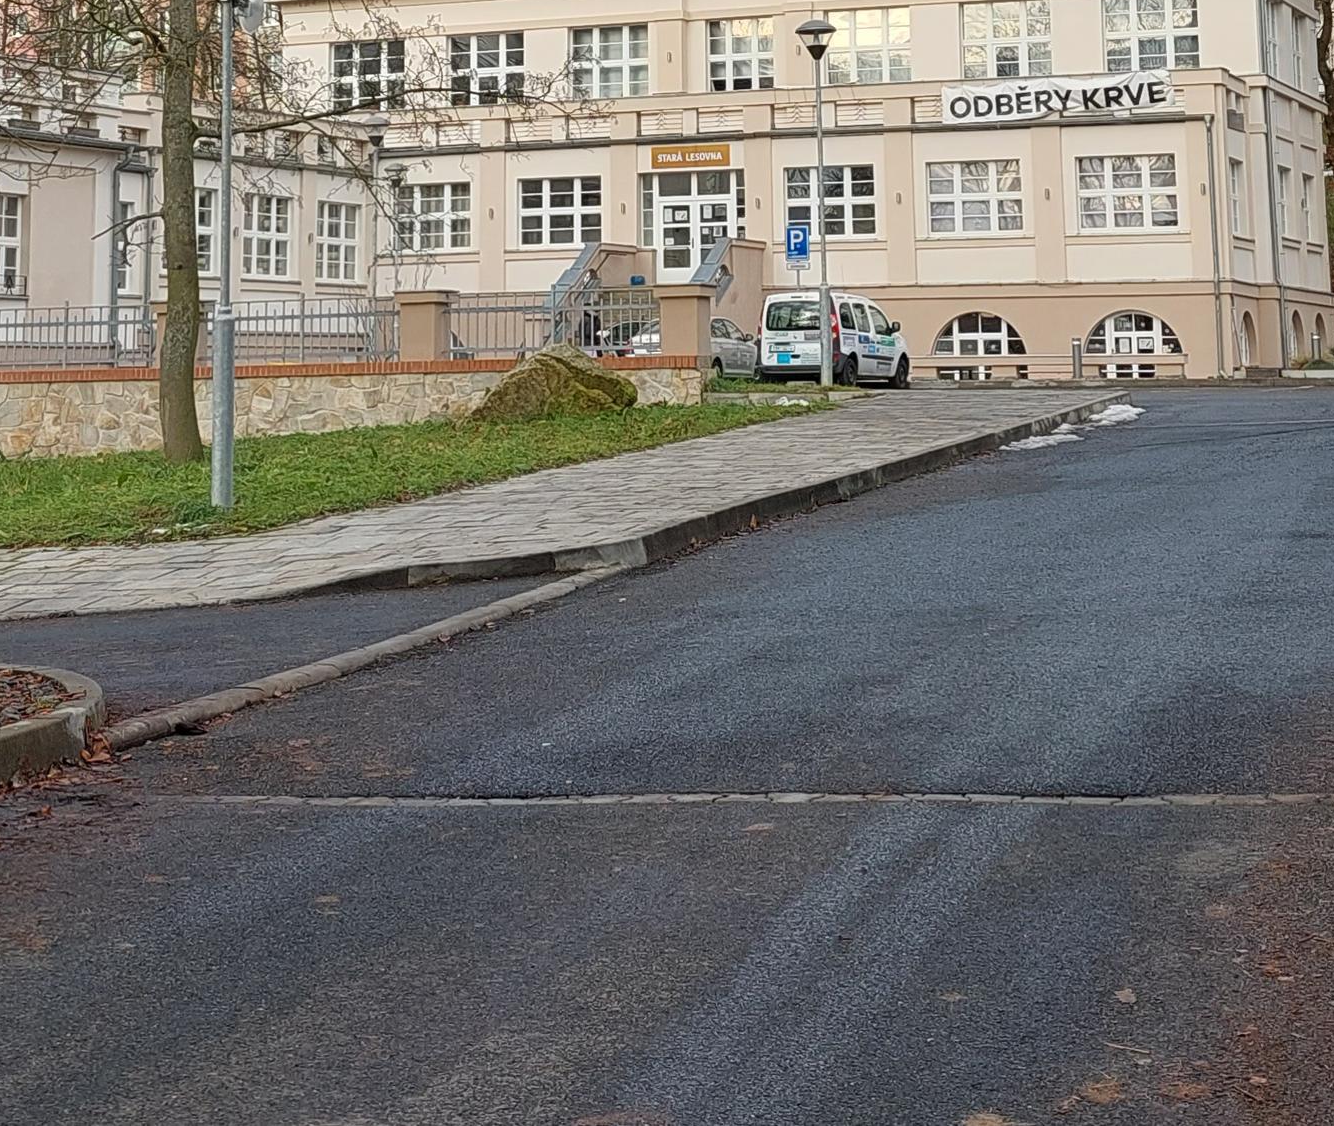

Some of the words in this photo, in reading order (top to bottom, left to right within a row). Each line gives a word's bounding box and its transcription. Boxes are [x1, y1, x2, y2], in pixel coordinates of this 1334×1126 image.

[949, 86, 1072, 119] ODBĚRY
[1081, 80, 1168, 111] KRVE
[657, 150, 683, 162] STARÁ
[685, 151, 723, 162] LESOVNA
[790, 230, 804, 250] P
